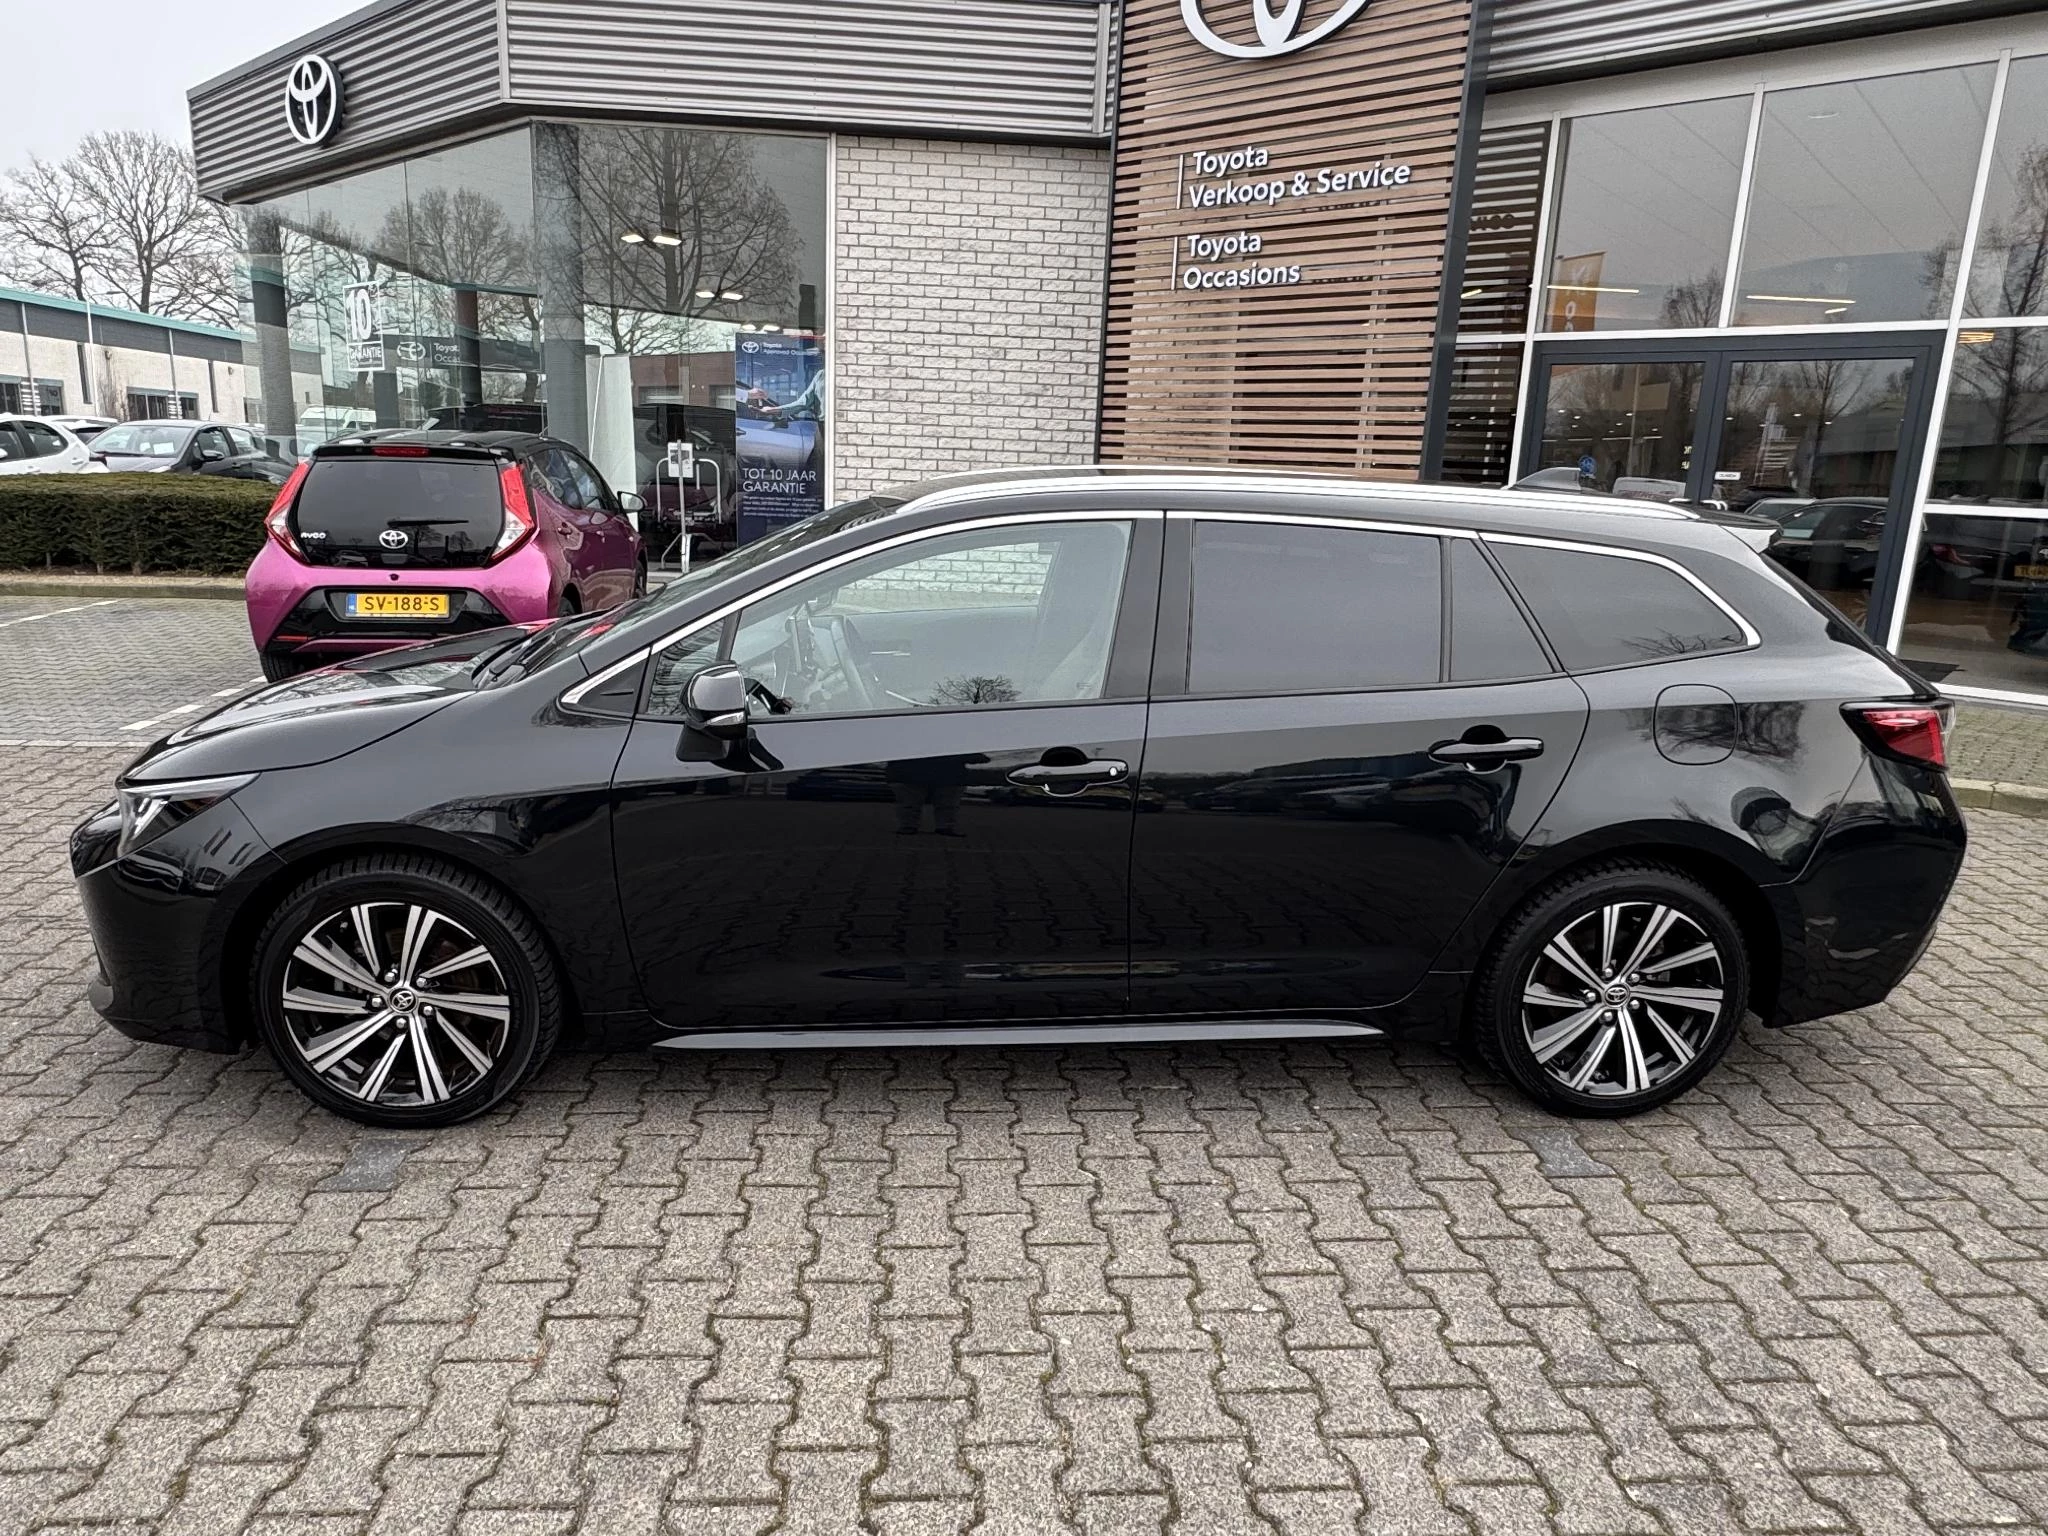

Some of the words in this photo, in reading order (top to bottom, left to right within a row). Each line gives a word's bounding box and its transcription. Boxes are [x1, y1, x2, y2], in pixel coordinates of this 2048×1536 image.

[1192, 146, 1269, 178] Toyota
[1188, 179, 1286, 208] Verkoop
[1291, 172, 1310, 197] &
[1316, 161, 1411, 194] Service
[1186, 231, 1262, 262] Toyota
[1182, 262, 1301, 290] Occasions
[345, 288, 372, 341] 10
[742, 467, 766, 480] TOT
[769, 469, 783, 480] 10
[786, 469, 817, 482] JAAR
[742, 480, 807, 494] GARANTIE
[364, 596, 440, 611] SV-188-S
